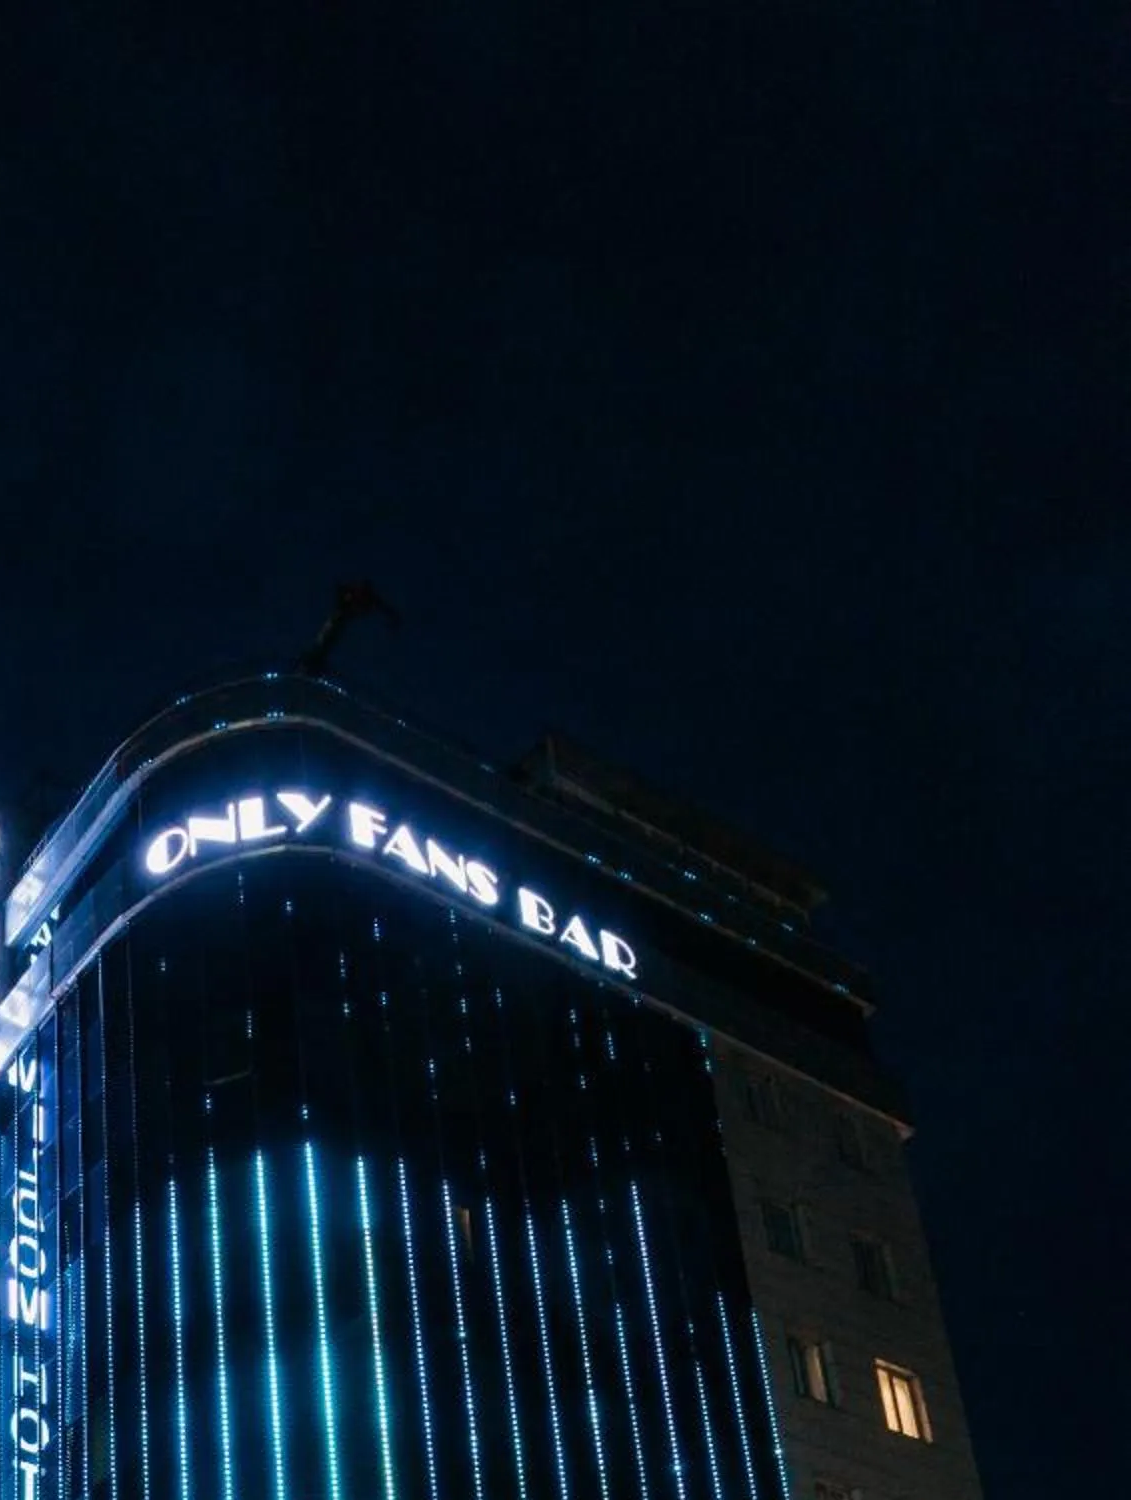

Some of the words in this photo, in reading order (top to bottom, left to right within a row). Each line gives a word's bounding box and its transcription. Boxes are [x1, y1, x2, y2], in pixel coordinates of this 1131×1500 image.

[146, 793, 331, 875] ONLY
[349, 802, 499, 905] FANS
[517, 887, 638, 980] BAR
